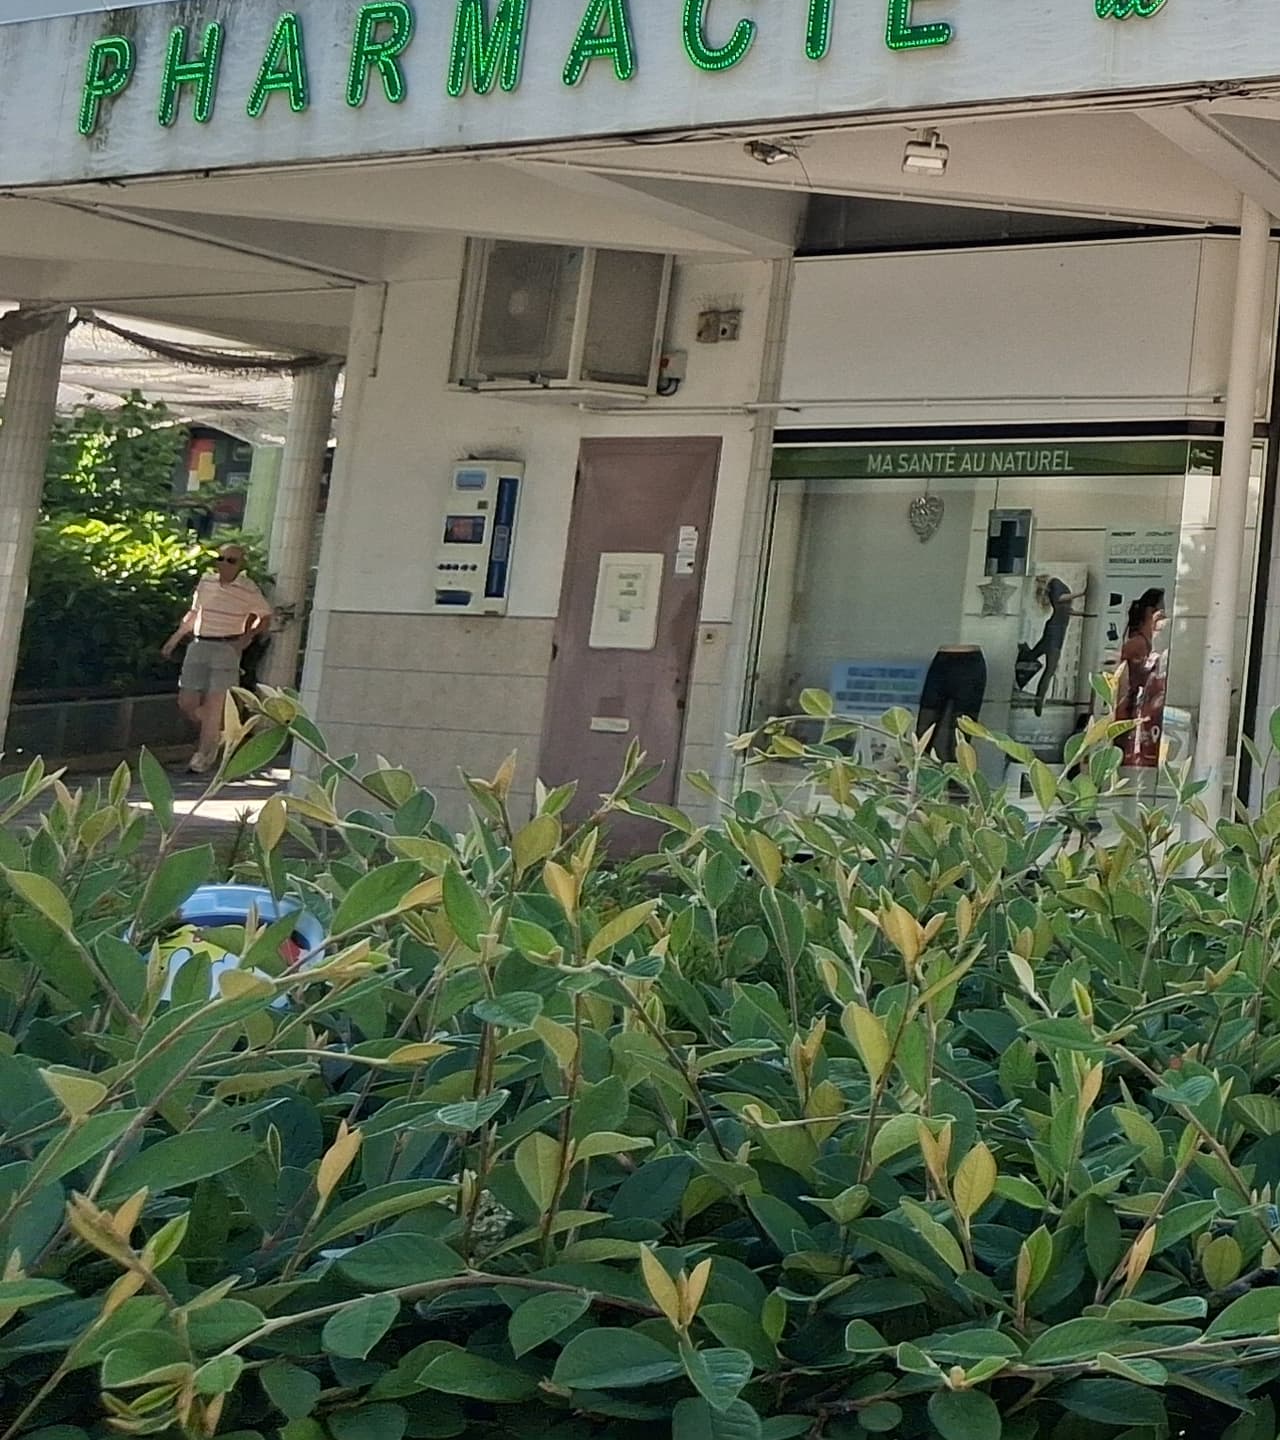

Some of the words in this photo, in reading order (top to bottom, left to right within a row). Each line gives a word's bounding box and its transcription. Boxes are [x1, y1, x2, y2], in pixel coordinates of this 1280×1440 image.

[867, 453, 893, 474] MA
[897, 447, 955, 473] SANTÉ
[959, 452, 986, 472] AU
[989, 450, 1074, 471] NATUREL
